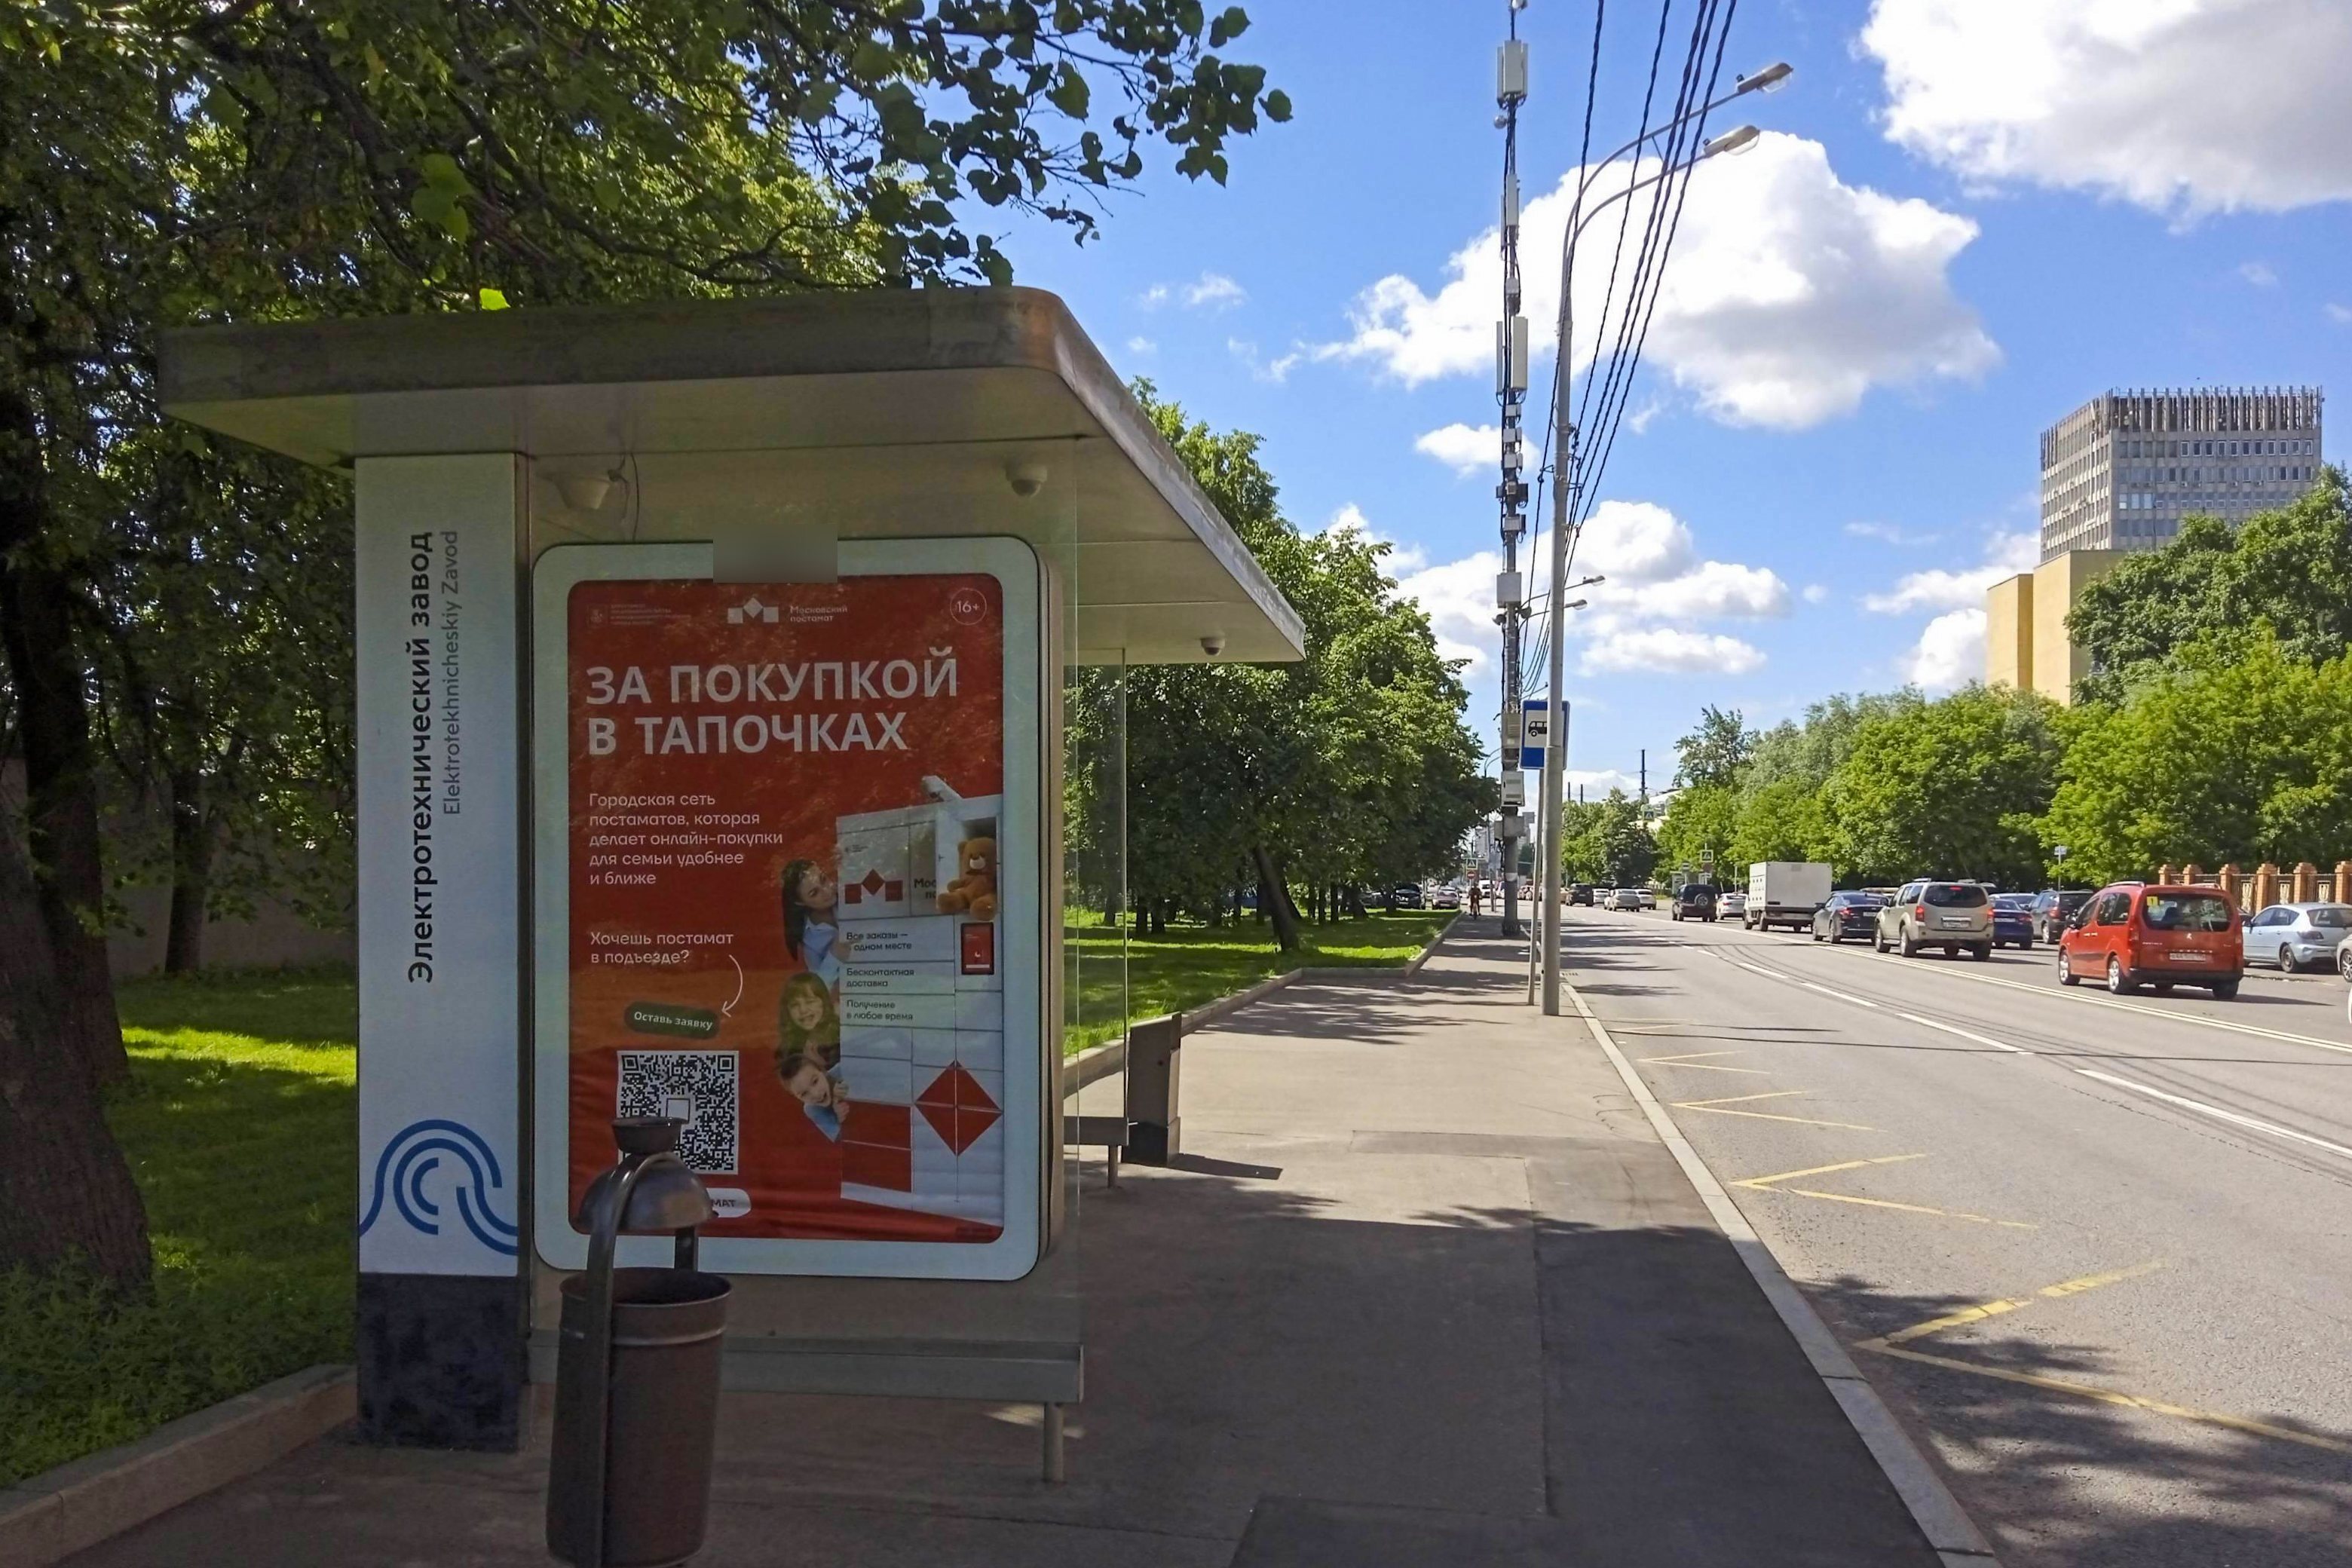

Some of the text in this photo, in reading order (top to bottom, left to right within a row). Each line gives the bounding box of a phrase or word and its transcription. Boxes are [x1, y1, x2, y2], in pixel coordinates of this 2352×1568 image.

[789, 605, 847, 614] Московский
[957, 600, 980, 613] 16+
[440, 531, 462, 814] Elektrotekhnicheskiy Zavod
[586, 646, 957, 704] ЗА ПОКУПКОЙ
[588, 712, 908, 755] В ТАПОЧКАХ
[406, 532, 438, 983] Электротехнический завод
[590, 793, 715, 809] Городская сеть
[590, 813, 760, 828] постаматов, которая
[590, 831, 783, 847] делает онлайн-покупки
[590, 850, 744, 868] для семьи удобнее
[590, 871, 657, 885] и ближе
[590, 932, 734, 945] Хочешь постамат
[846, 932, 864, 940] Все
[866, 931, 898, 939] заказы
[854, 943, 883, 951] одном
[591, 950, 689, 965] в подъезде?
[846, 967, 914, 977] Бесконтактная
[847, 1000, 896, 1009] Получение
[634, 1011, 713, 1031] Оставь заявку
[854, 1011, 883, 1021] любое
[885, 1013, 913, 1022] время
